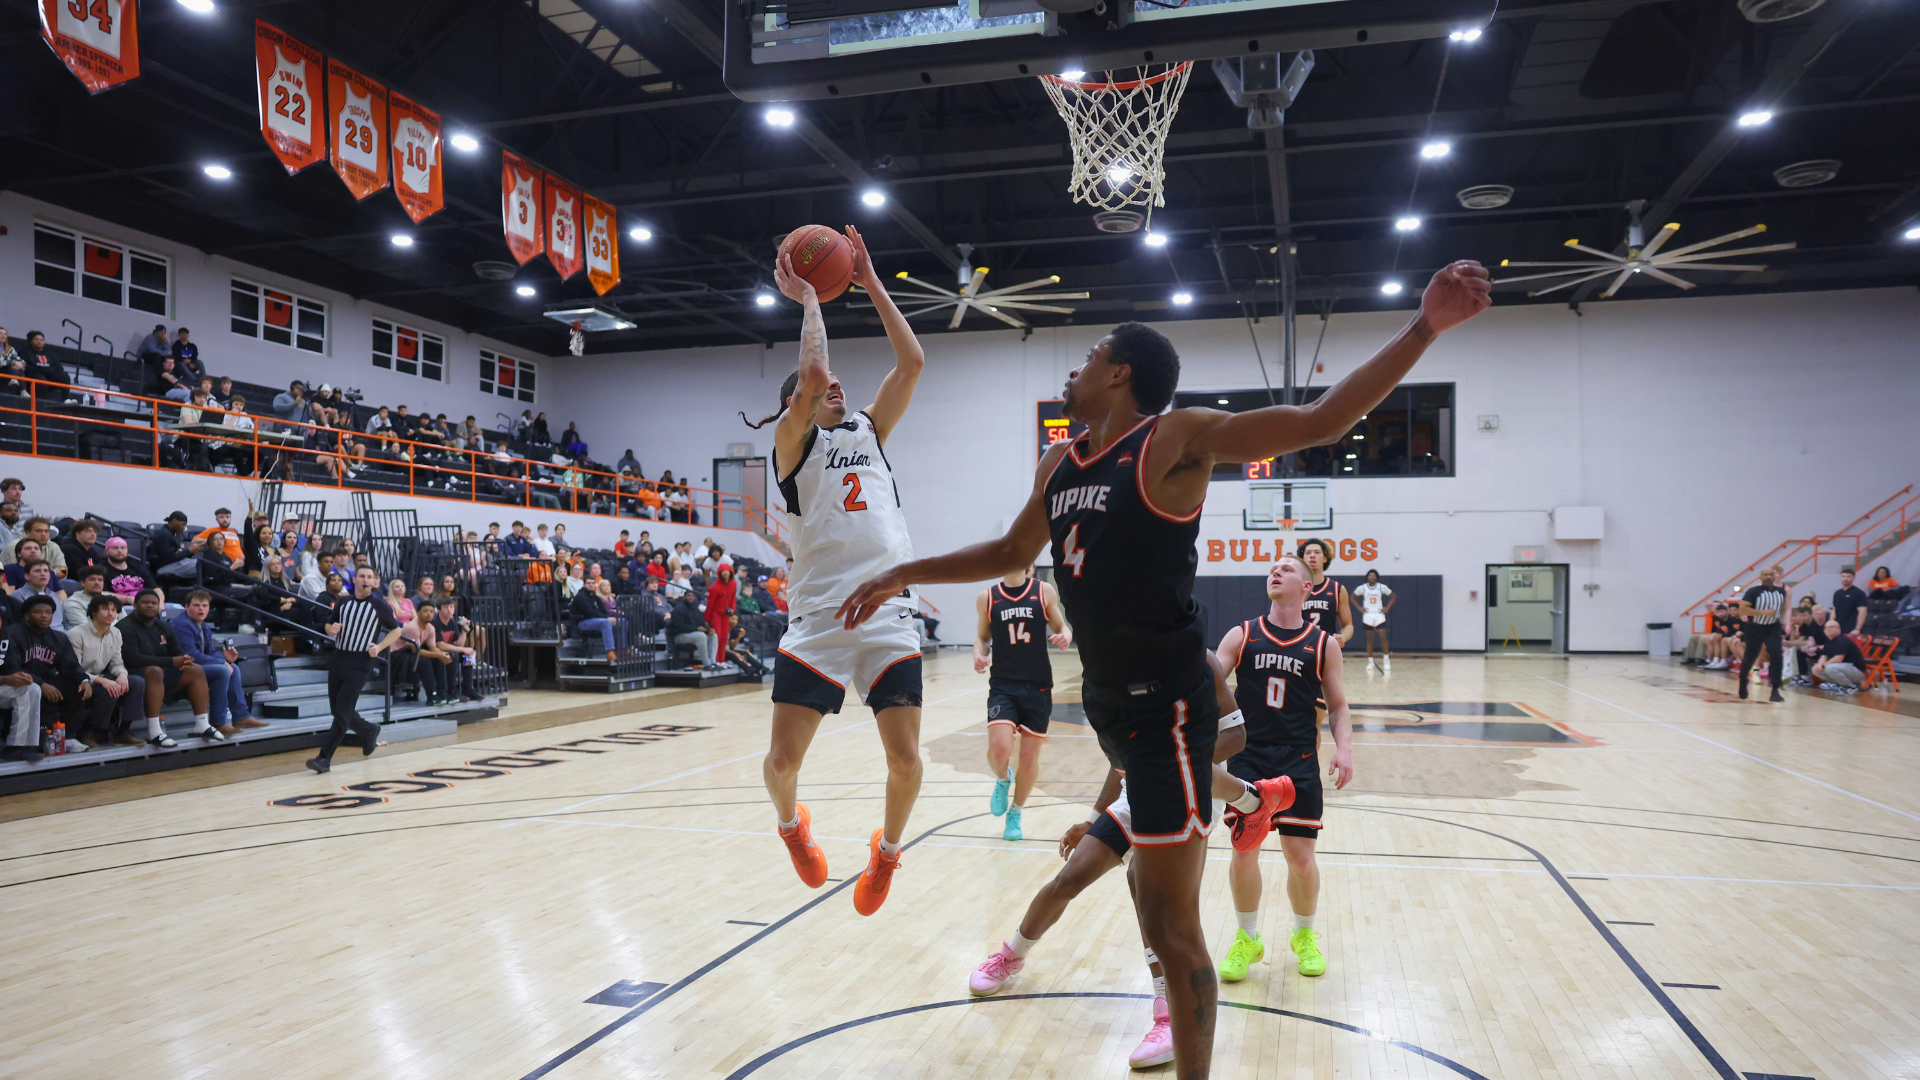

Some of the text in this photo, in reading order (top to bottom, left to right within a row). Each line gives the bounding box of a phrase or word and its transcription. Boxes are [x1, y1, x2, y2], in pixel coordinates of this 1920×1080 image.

[55, 37, 124, 74] AMBER SPENCER
[278, 70, 304, 90] SWIM
[275, 84, 306, 126] 22
[345, 118, 373, 154] 29
[407, 141, 427, 172] 10
[519, 200, 528, 225] 3
[592, 235, 609, 261] 33
[796, 230, 828, 264] LEGACY
[1047, 427, 1069, 444] 50
[825, 447, 871, 470] Union
[1247, 460, 1272, 480] 27
[843, 472, 867, 512] 2
[1051, 485, 1112, 520] UPIKE
[1062, 521, 1087, 577] 4
[1000, 607, 1034, 621] UPIKE
[1301, 600, 1330, 611] UPIKE
[1008, 621, 1032, 646] 14
[1254, 653, 1305, 678] UPIKE
[1266, 675, 1287, 710] 0
[267, 724, 717, 811] BULLDOGS
